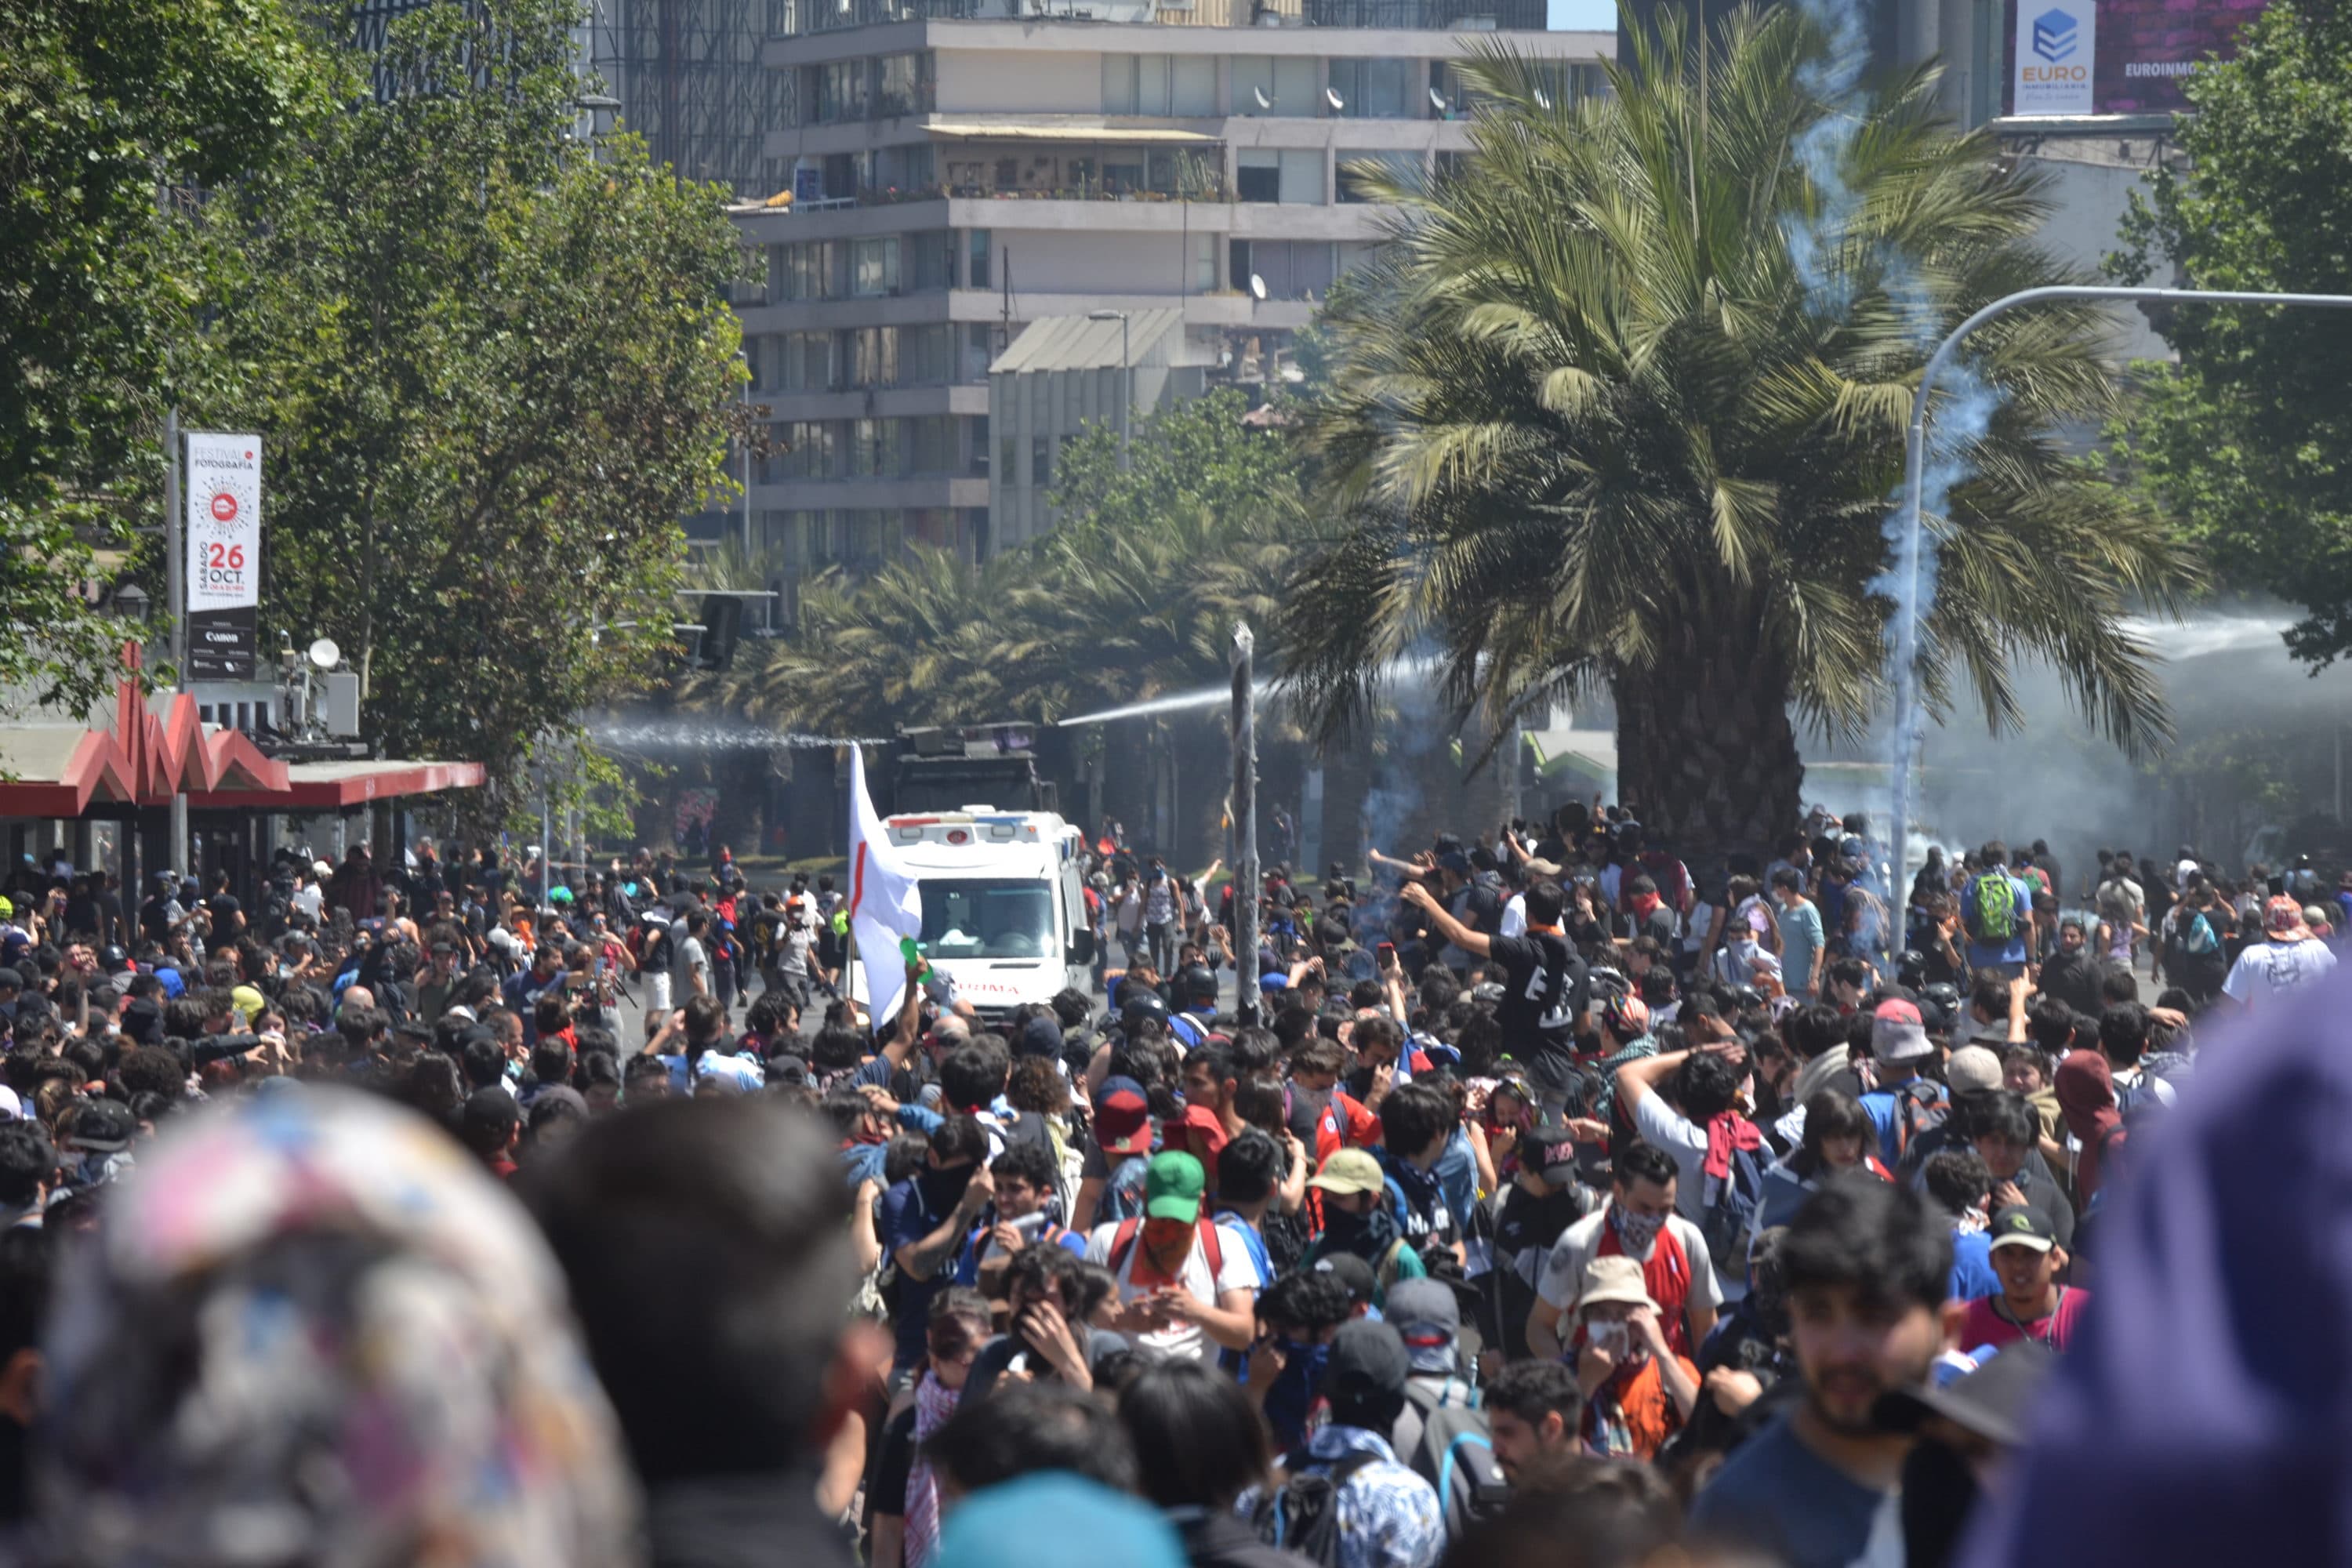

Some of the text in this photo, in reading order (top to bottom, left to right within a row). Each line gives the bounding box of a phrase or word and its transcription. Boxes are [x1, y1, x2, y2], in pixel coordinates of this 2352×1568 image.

[2022, 66, 2087, 82] EURO
[194, 446, 242, 460] FESTIVAL
[209, 543, 245, 570] 26
[205, 630, 238, 643] Canon
